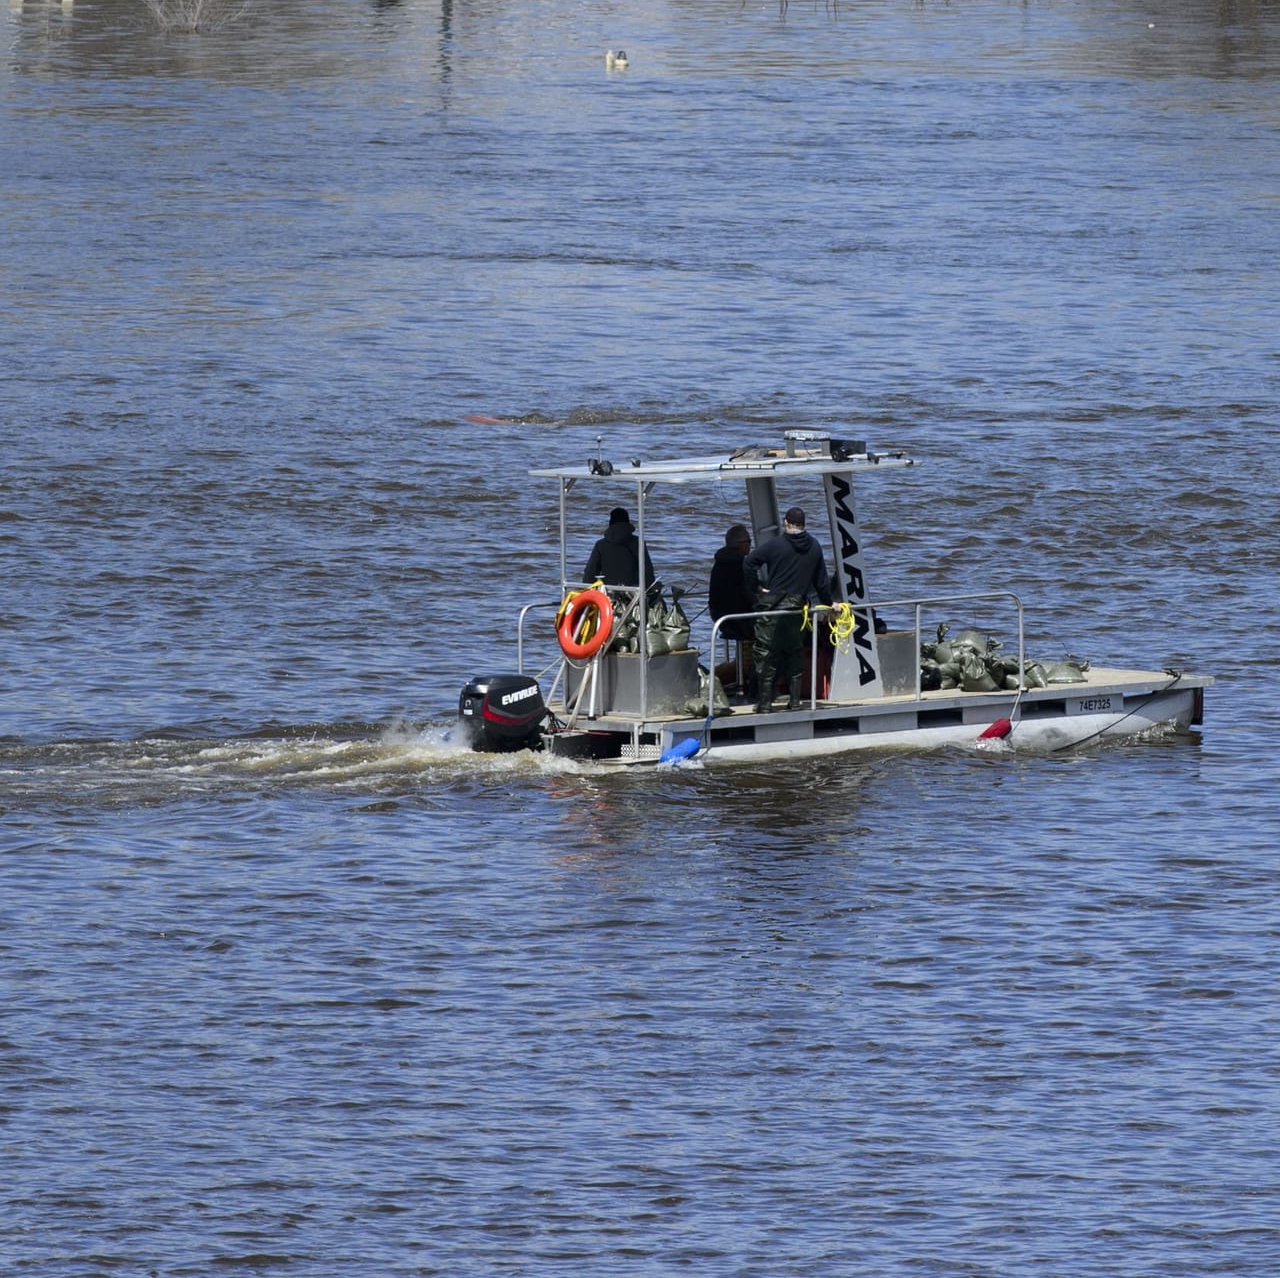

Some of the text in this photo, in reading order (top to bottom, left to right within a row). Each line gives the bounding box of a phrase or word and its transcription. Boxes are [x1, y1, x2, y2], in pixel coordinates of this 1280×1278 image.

[831, 475, 876, 686] MARINA
[501, 684, 538, 706] EVINRUDE
[1079, 698, 1111, 711] 74E7325
